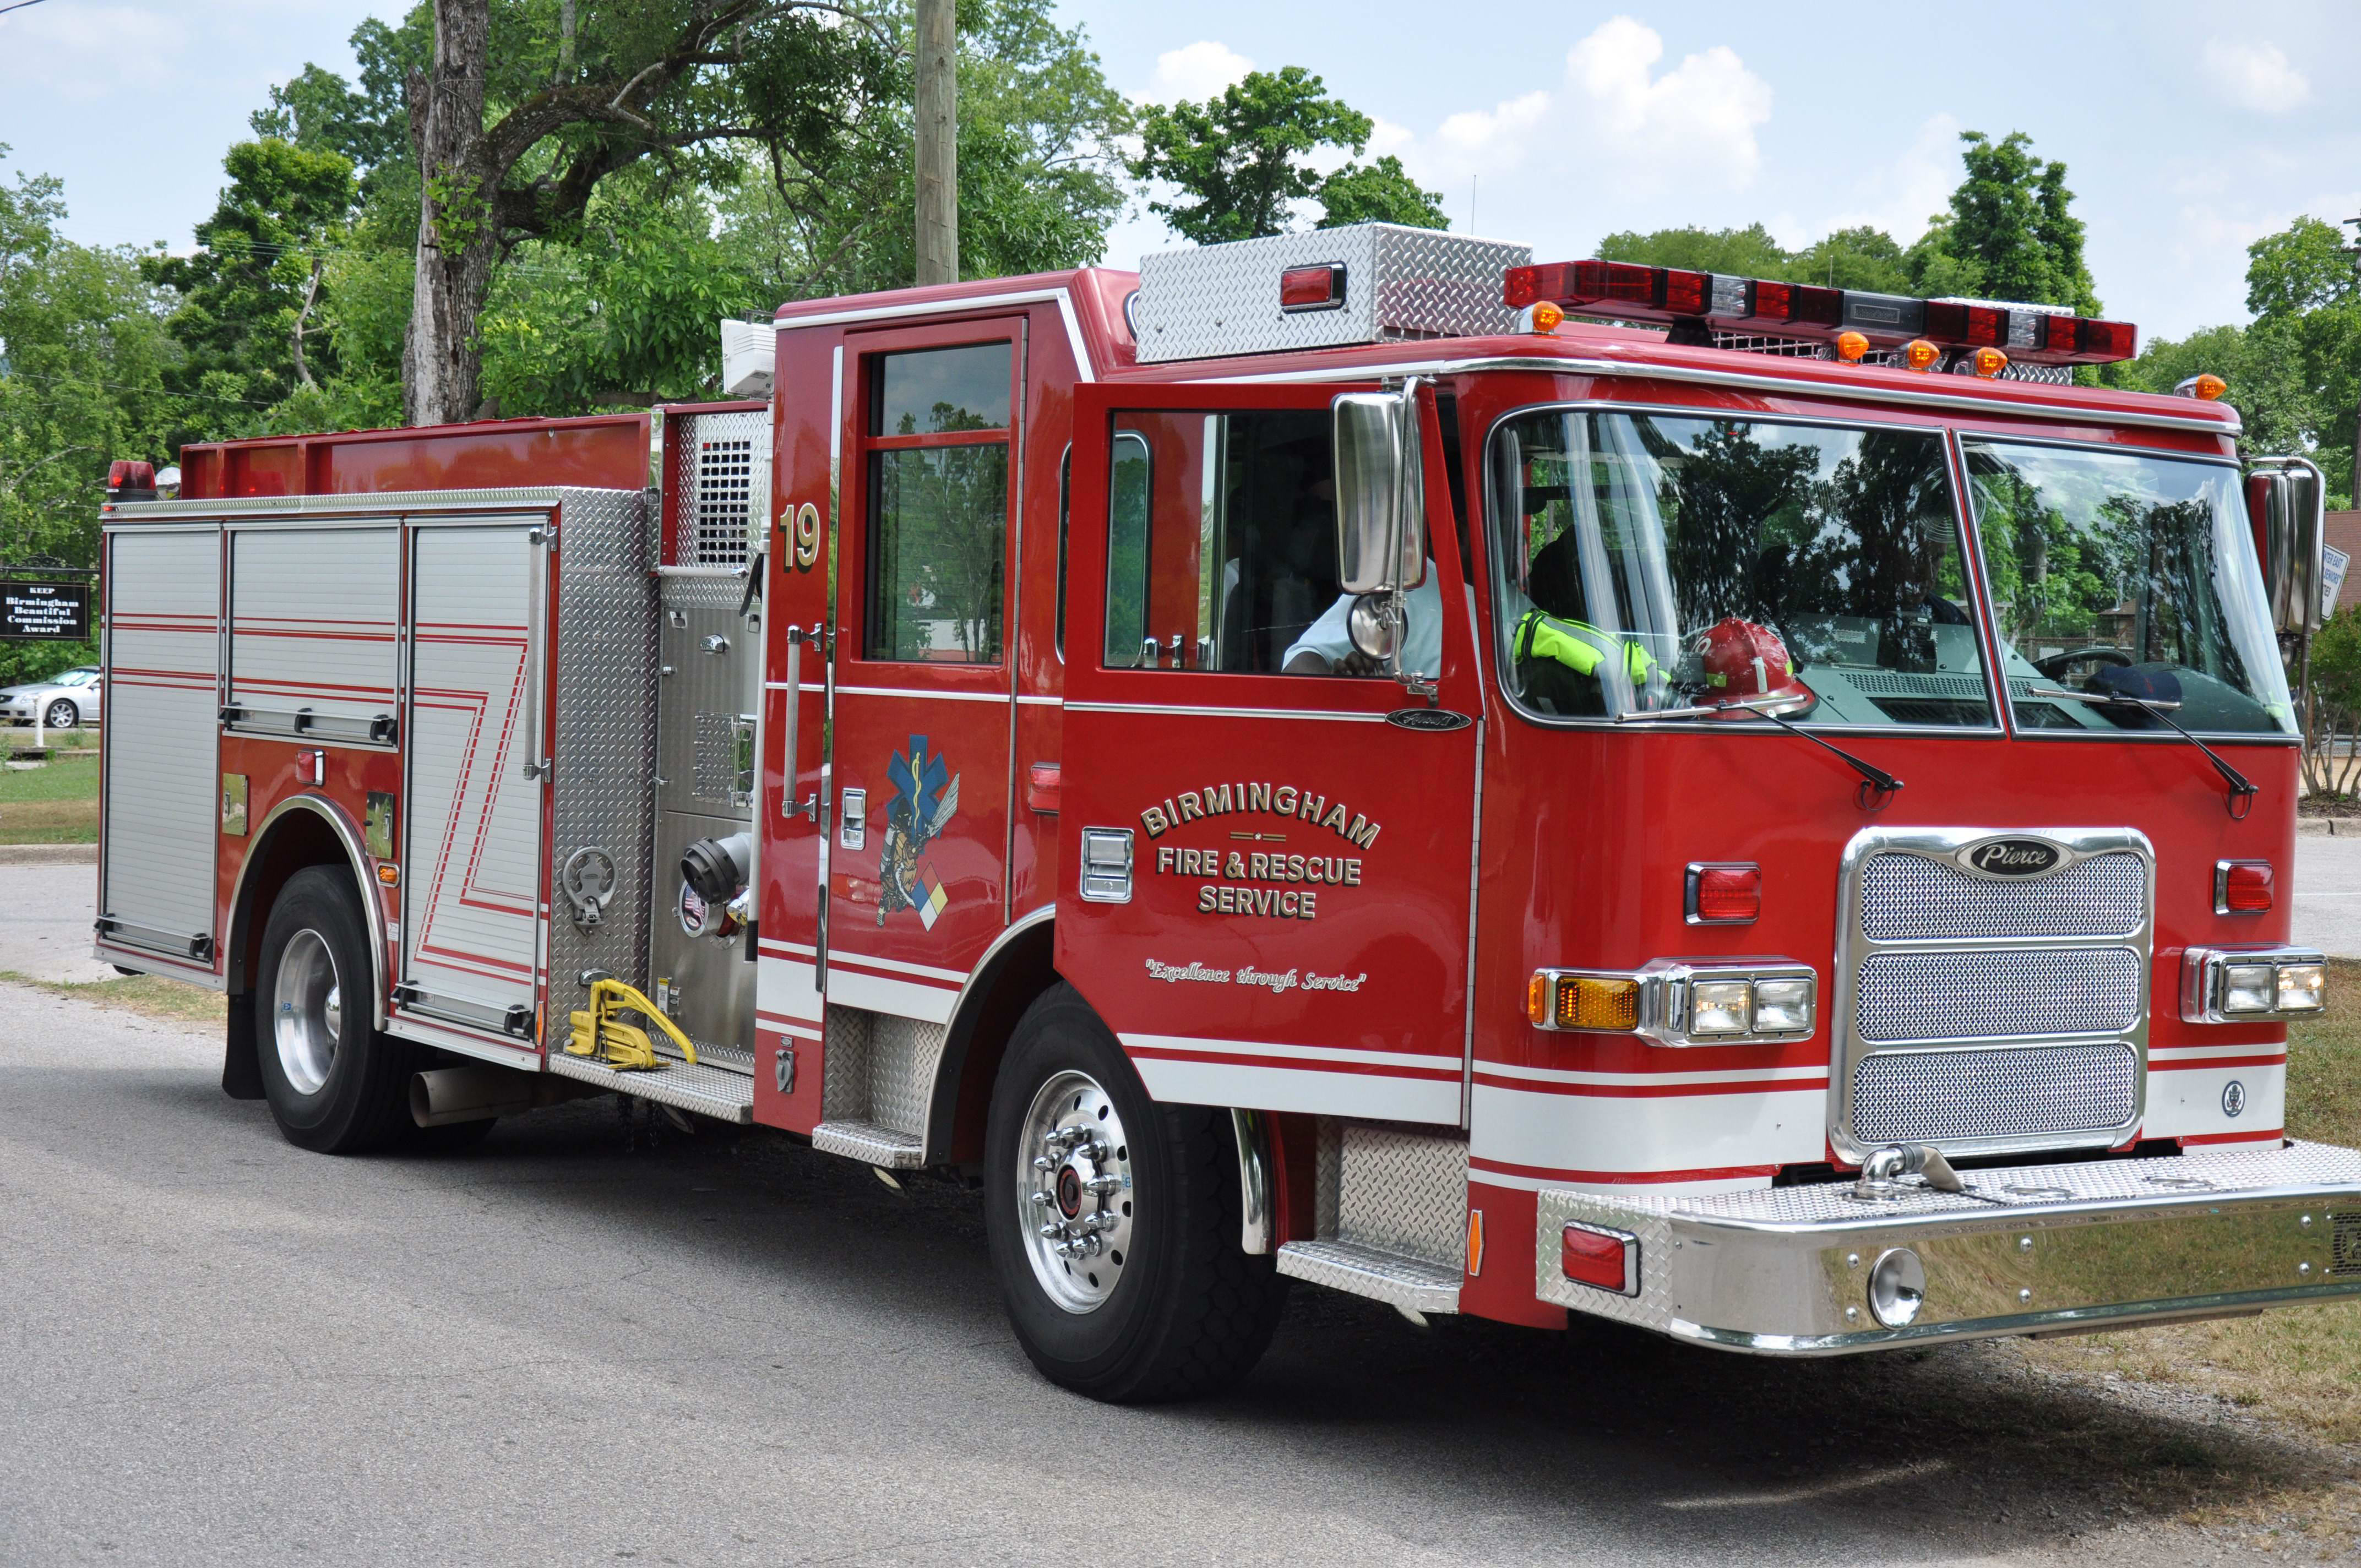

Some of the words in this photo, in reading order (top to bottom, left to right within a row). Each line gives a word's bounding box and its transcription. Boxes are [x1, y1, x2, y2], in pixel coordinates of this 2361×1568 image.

[779, 502, 820, 569] 19
[6, 597, 79, 607] Birmingham
[14, 607, 71, 616] Beautiful
[7, 615, 77, 625] Commission
[22, 624, 61, 633] Award
[1140, 782, 1381, 851] BIRMINGHAM
[1156, 847, 1219, 877] FIRE
[1225, 852, 1245, 879] &
[1249, 853, 1362, 886] RESCUE
[1981, 844, 2048, 868] Pierce
[1198, 885, 1316, 919] SERVICE
[1145, 959, 1230, 983] "Excellence
[1236, 966, 1297, 993] through
[1301, 973, 1367, 992] Service"
